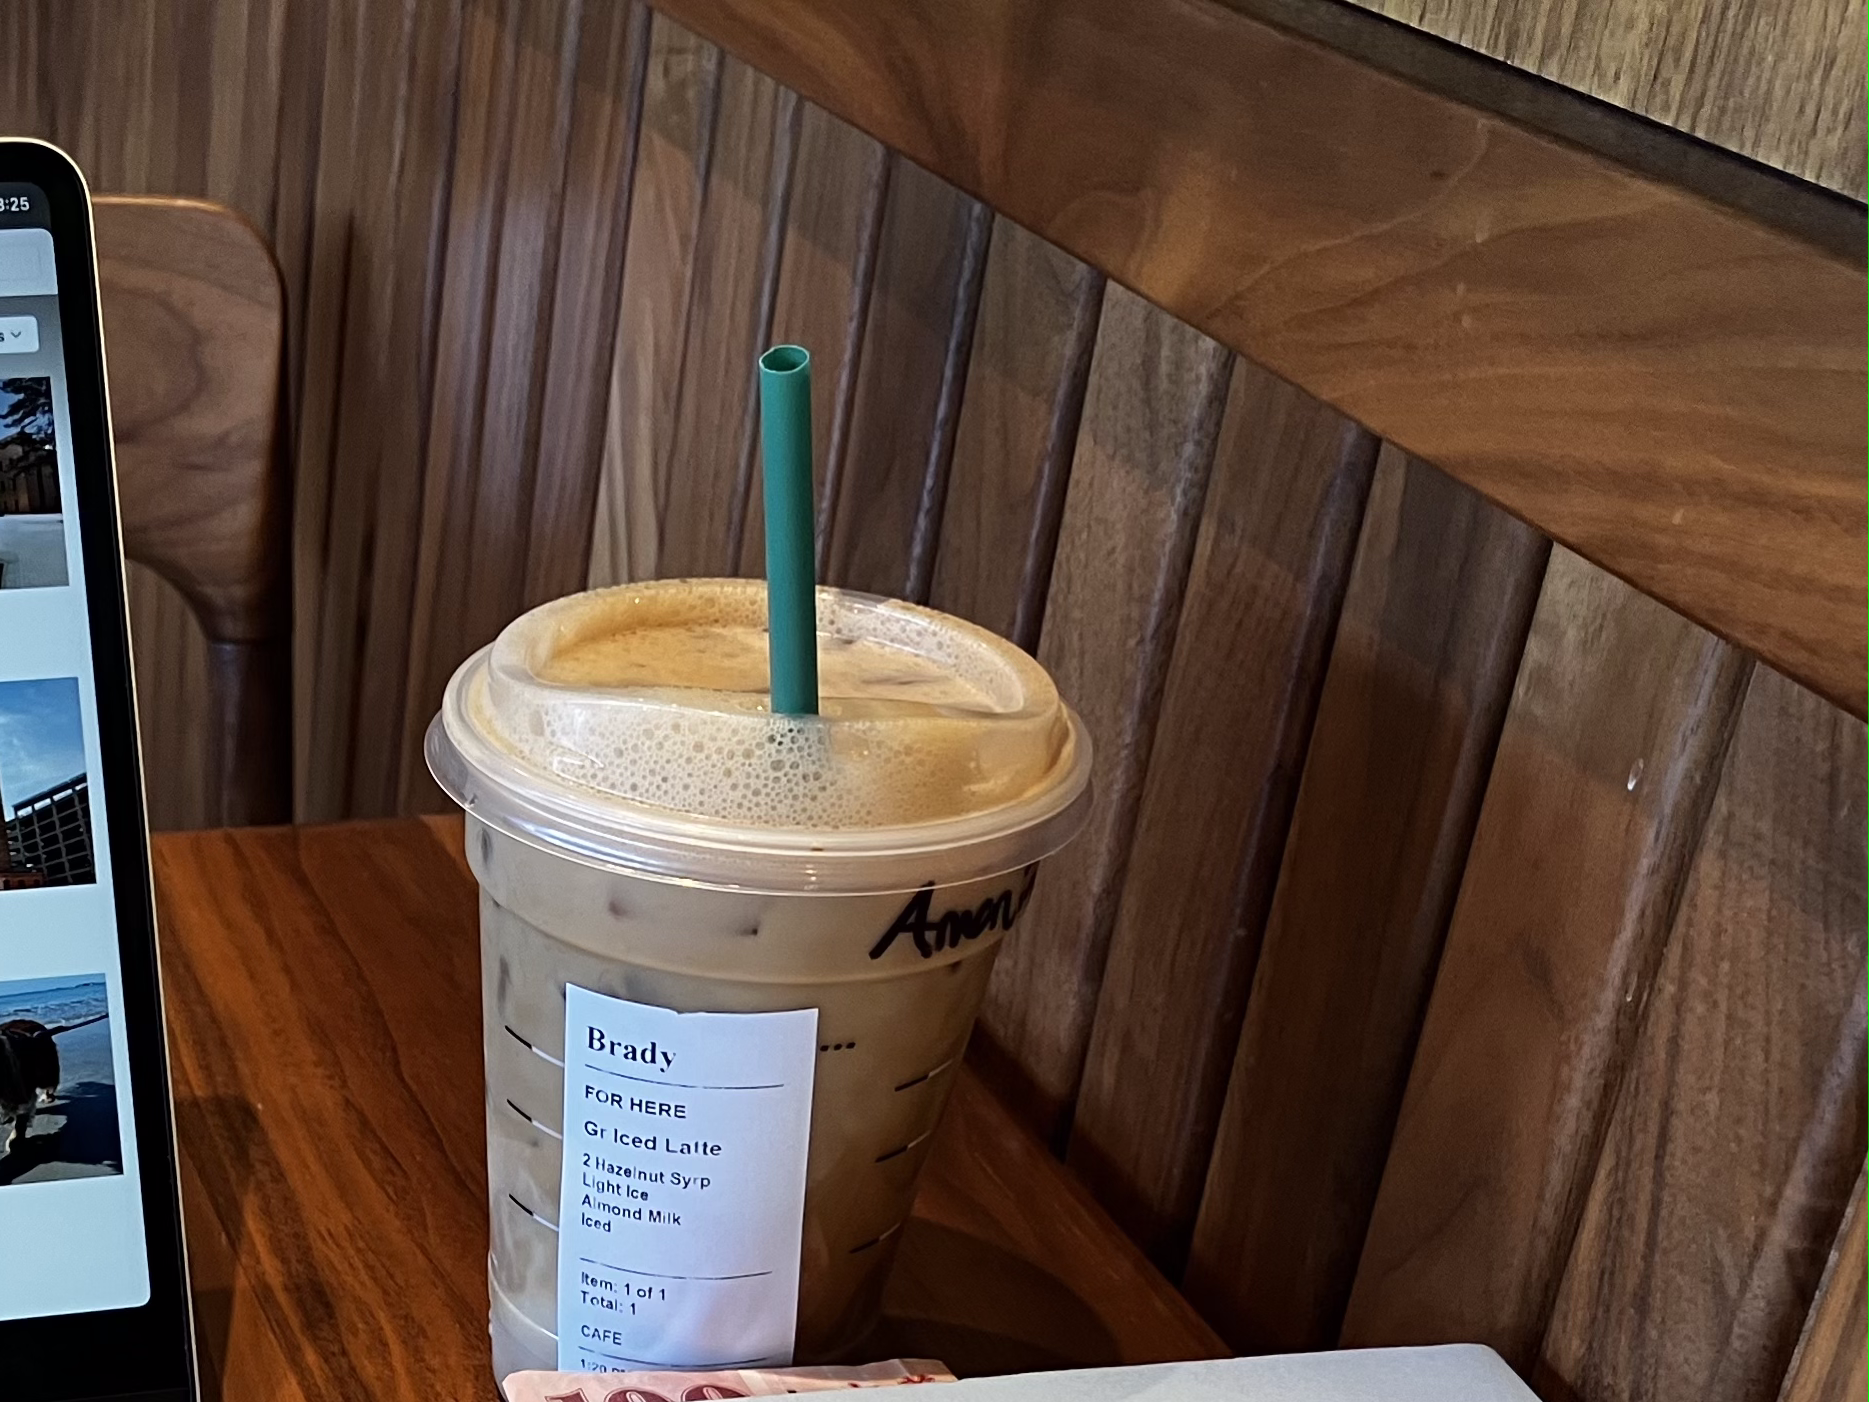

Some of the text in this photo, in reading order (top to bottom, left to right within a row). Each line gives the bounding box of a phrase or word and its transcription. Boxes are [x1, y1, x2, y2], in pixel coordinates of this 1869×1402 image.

[586, 1025, 677, 1072] Brady
[585, 1085, 687, 1119] FOR HERE
[584, 1120, 723, 1157] Gr Iced Latte
[582, 1153, 711, 1190] 2 Hazelnut Syrp
[582, 1173, 649, 1201] Light Ice
[581, 1194, 681, 1226] Almond Milk
[581, 1213, 611, 1234] Iced
[581, 1272, 667, 1302] Item: 1 of 1
[580, 1291, 637, 1316] Total: 1
[580, 1324, 622, 1346] CAFE
